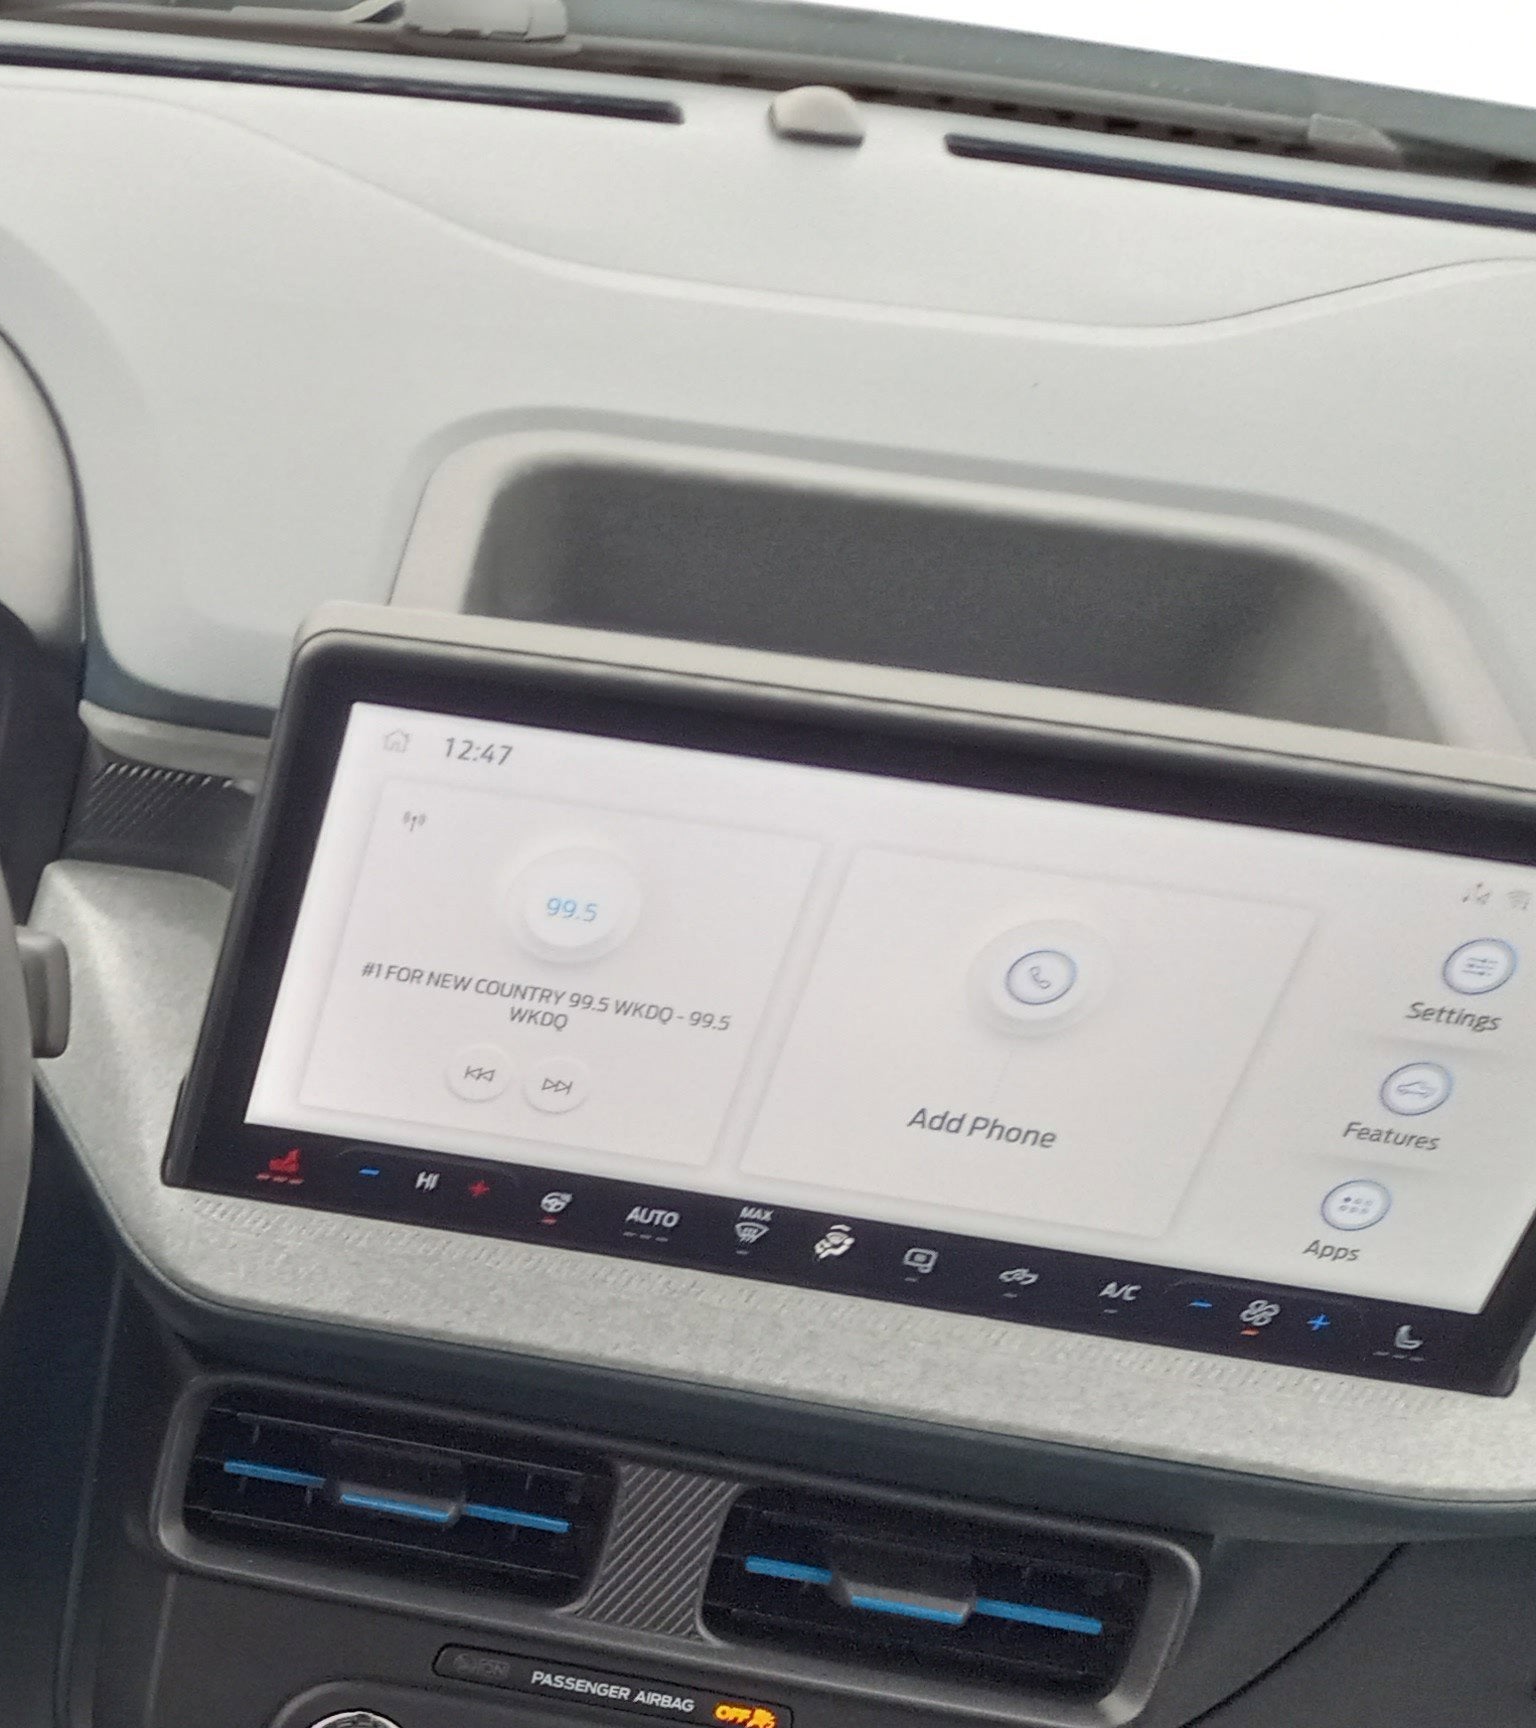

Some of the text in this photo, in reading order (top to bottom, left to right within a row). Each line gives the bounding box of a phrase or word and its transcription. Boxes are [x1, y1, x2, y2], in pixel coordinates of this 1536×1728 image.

[443, 735, 514, 767] 12:47
[545, 895, 599, 923] 99.5
[360, 961, 382, 980] #1
[384, 964, 424, 985] FOR
[425, 970, 473, 992] NEW
[475, 977, 566, 1007] COUNTRY
[568, 992, 610, 1013] 99.5
[612, 998, 675, 1026] WKDQ
[688, 1011, 733, 1032] 99.5
[507, 1006, 570, 1033] WKDQ
[1405, 1000, 1503, 1034] Settings
[905, 1106, 1058, 1150] Add Phone
[1341, 1120, 1441, 1153] Features
[415, 1170, 440, 1192] HI
[625, 1205, 680, 1229] AUTO
[739, 1206, 775, 1223] MAX
[1302, 1239, 1361, 1265] Apps
[1098, 1280, 1142, 1303] A/C
[530, 1670, 631, 1701] PASSENGER
[633, 1689, 696, 1713] AIRBAG
